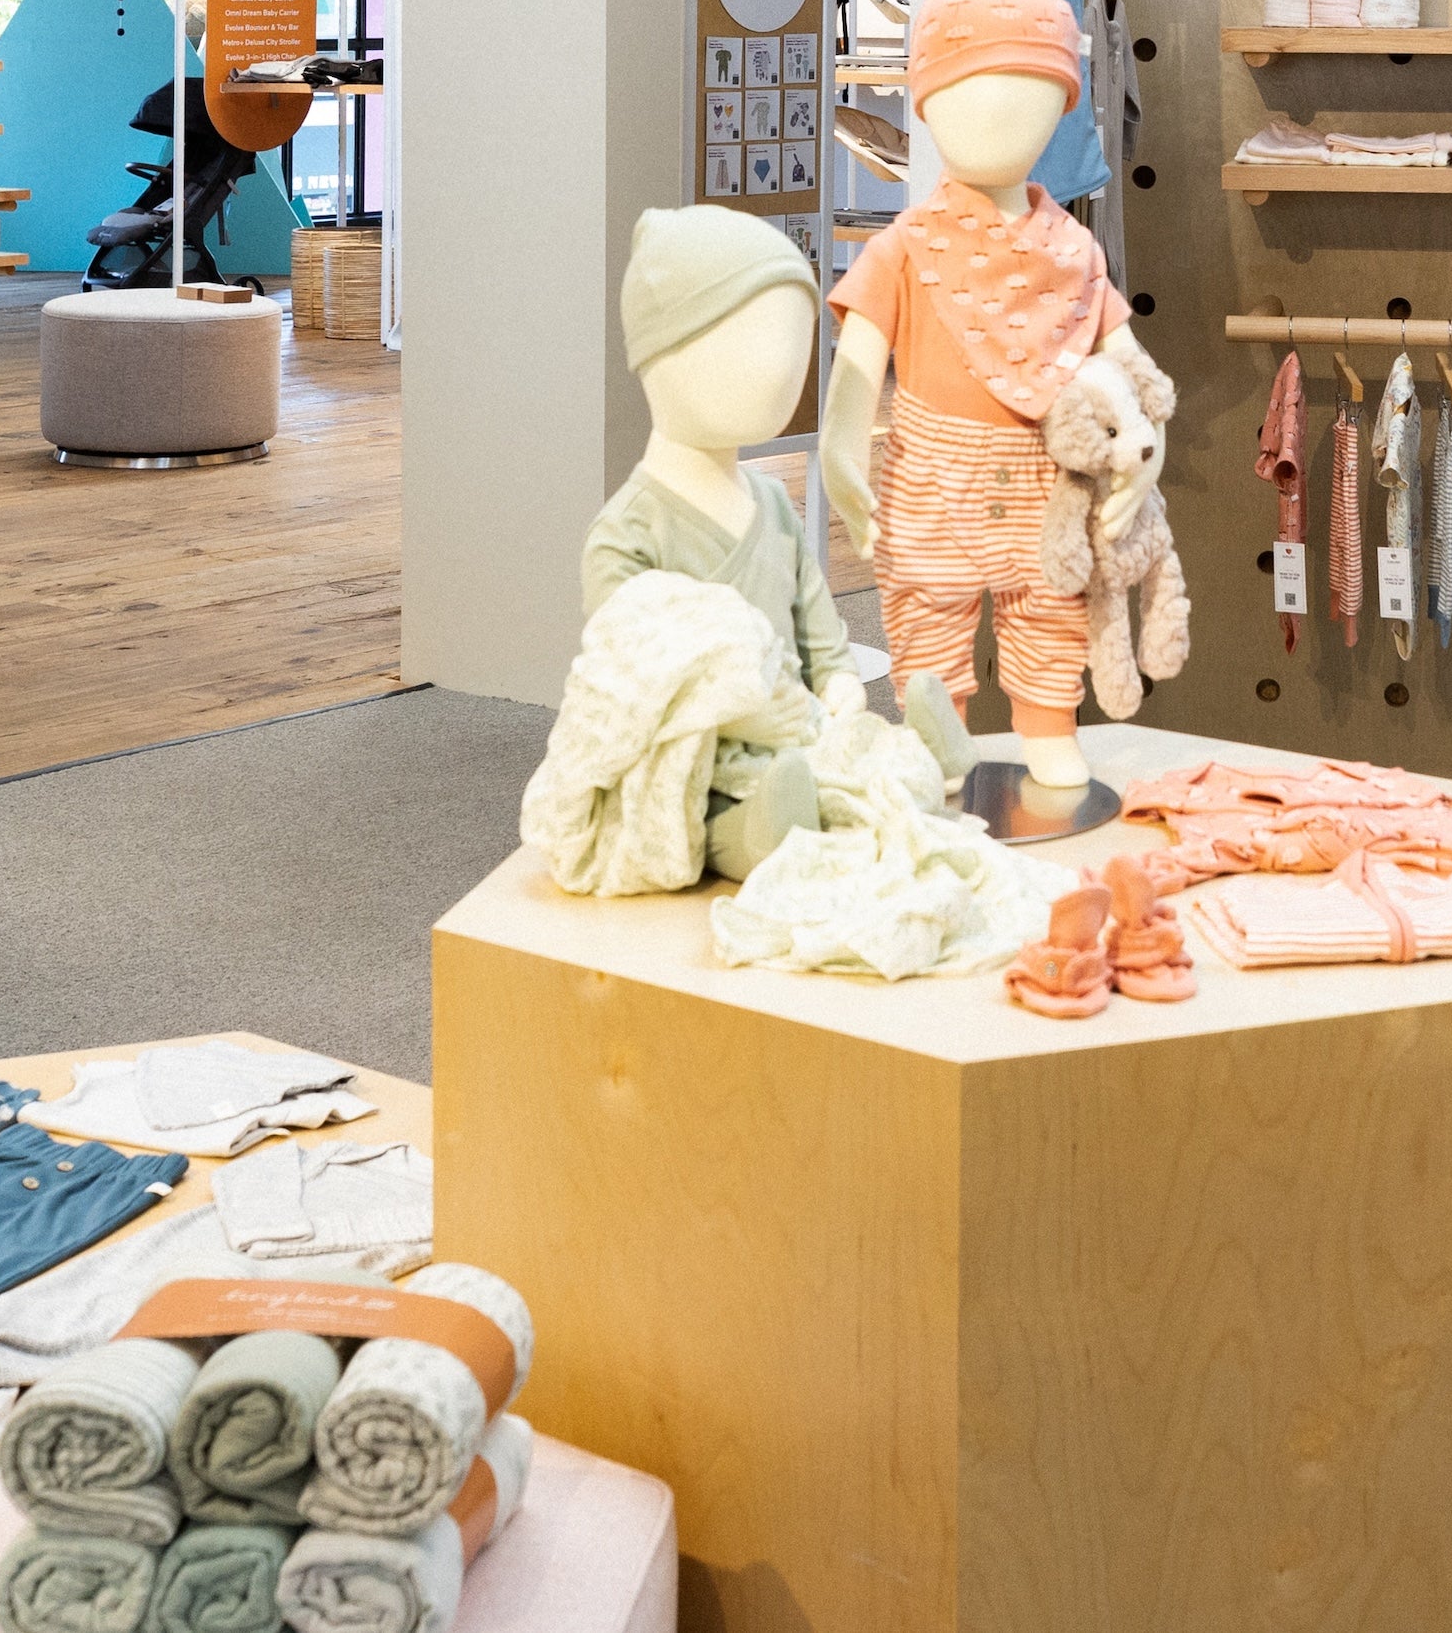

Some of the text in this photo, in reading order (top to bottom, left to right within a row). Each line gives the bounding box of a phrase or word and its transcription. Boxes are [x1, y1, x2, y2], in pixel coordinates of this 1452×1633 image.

[225, 9, 242, 17] Omni
[242, 9, 262, 17] Dream
[263, 9, 278, 18] Baby
[225, 24, 244, 32] Evolve
[245, 24, 269, 32] Bouncer
[277, 24, 287, 32] Toy
[222, 39, 244, 47] Metro+
[266, 38, 278, 47] City
[279, 38, 301, 46] Stroller
[225, 52, 297, 61] Evolve 3-in-1 High Chair
